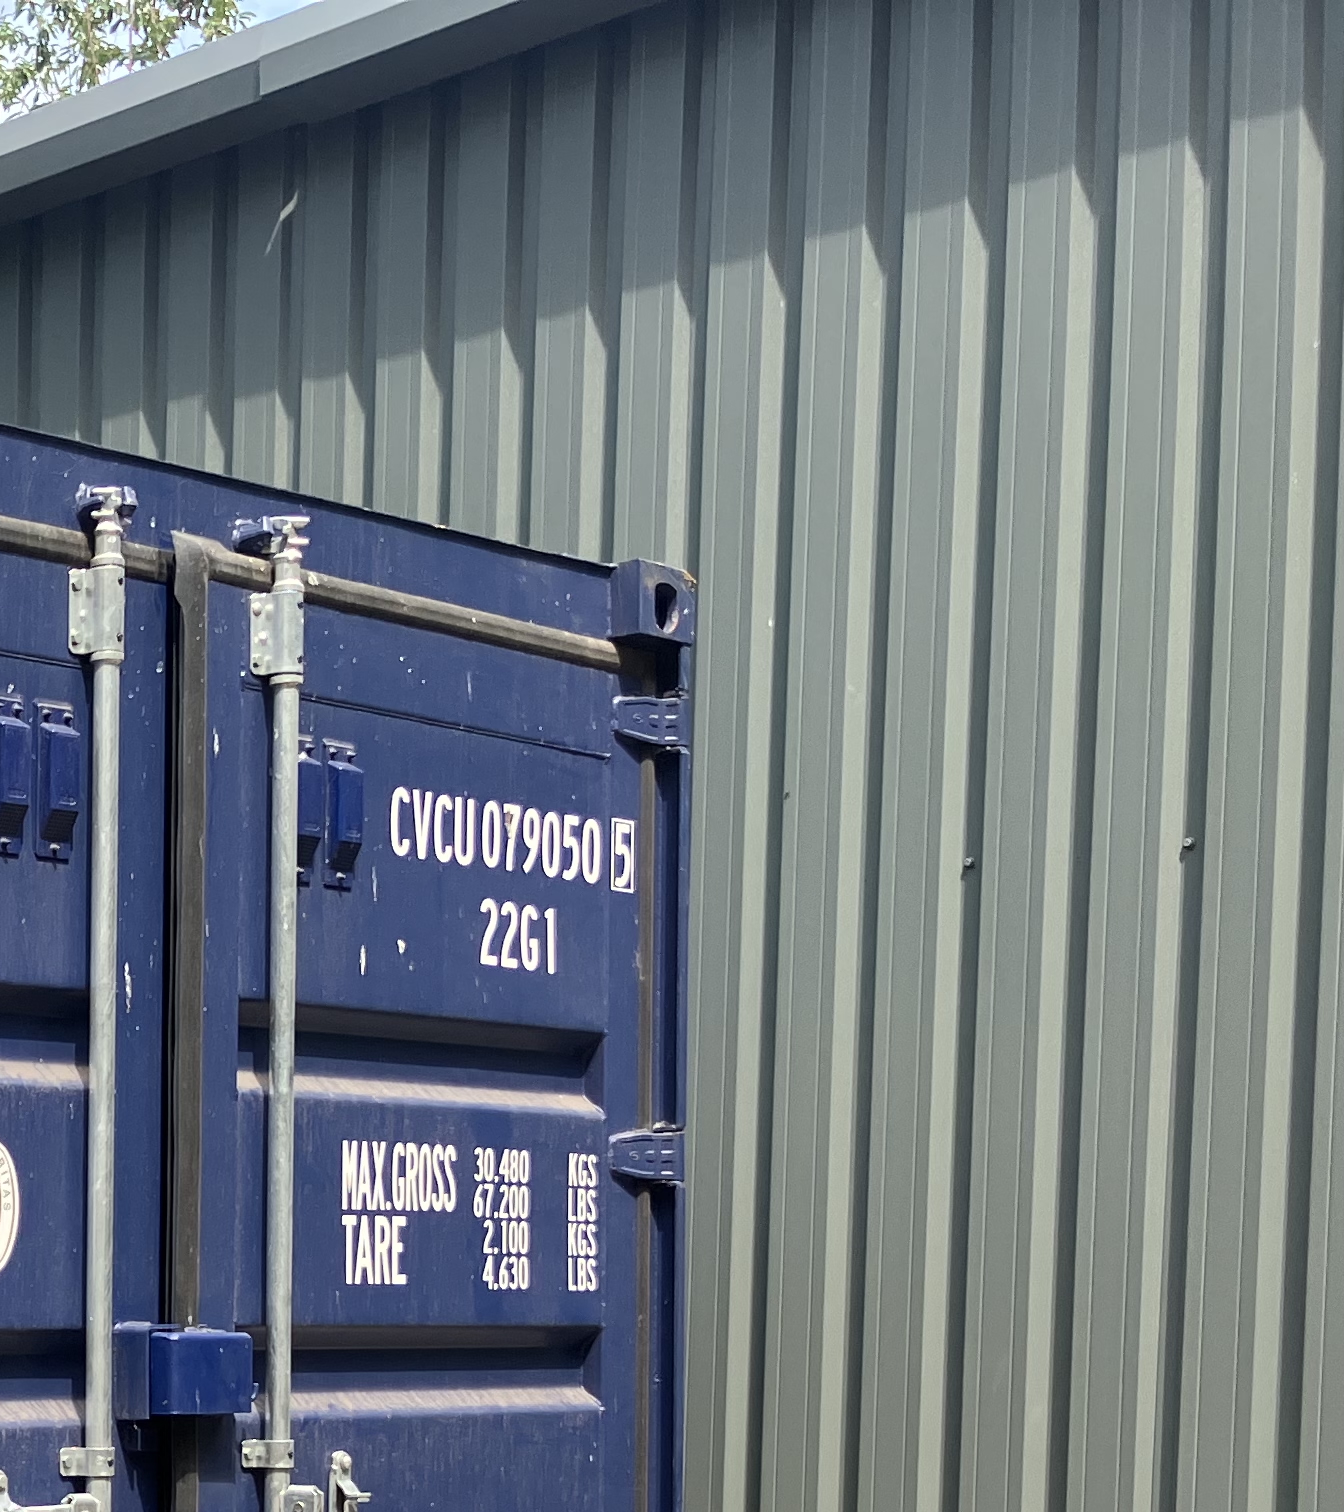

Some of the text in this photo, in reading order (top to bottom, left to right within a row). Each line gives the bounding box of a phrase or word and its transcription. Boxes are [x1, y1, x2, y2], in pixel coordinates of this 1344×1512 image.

[390, 786, 631, 888] CVCU 079050 5
[479, 897, 558, 975] 22G1
[567, 1152, 598, 1188] KGS
[567, 1187, 598, 1223] LBS
[341, 1214, 598, 1285] TARE 2,100 KGS
[567, 1257, 598, 1292] LBS
